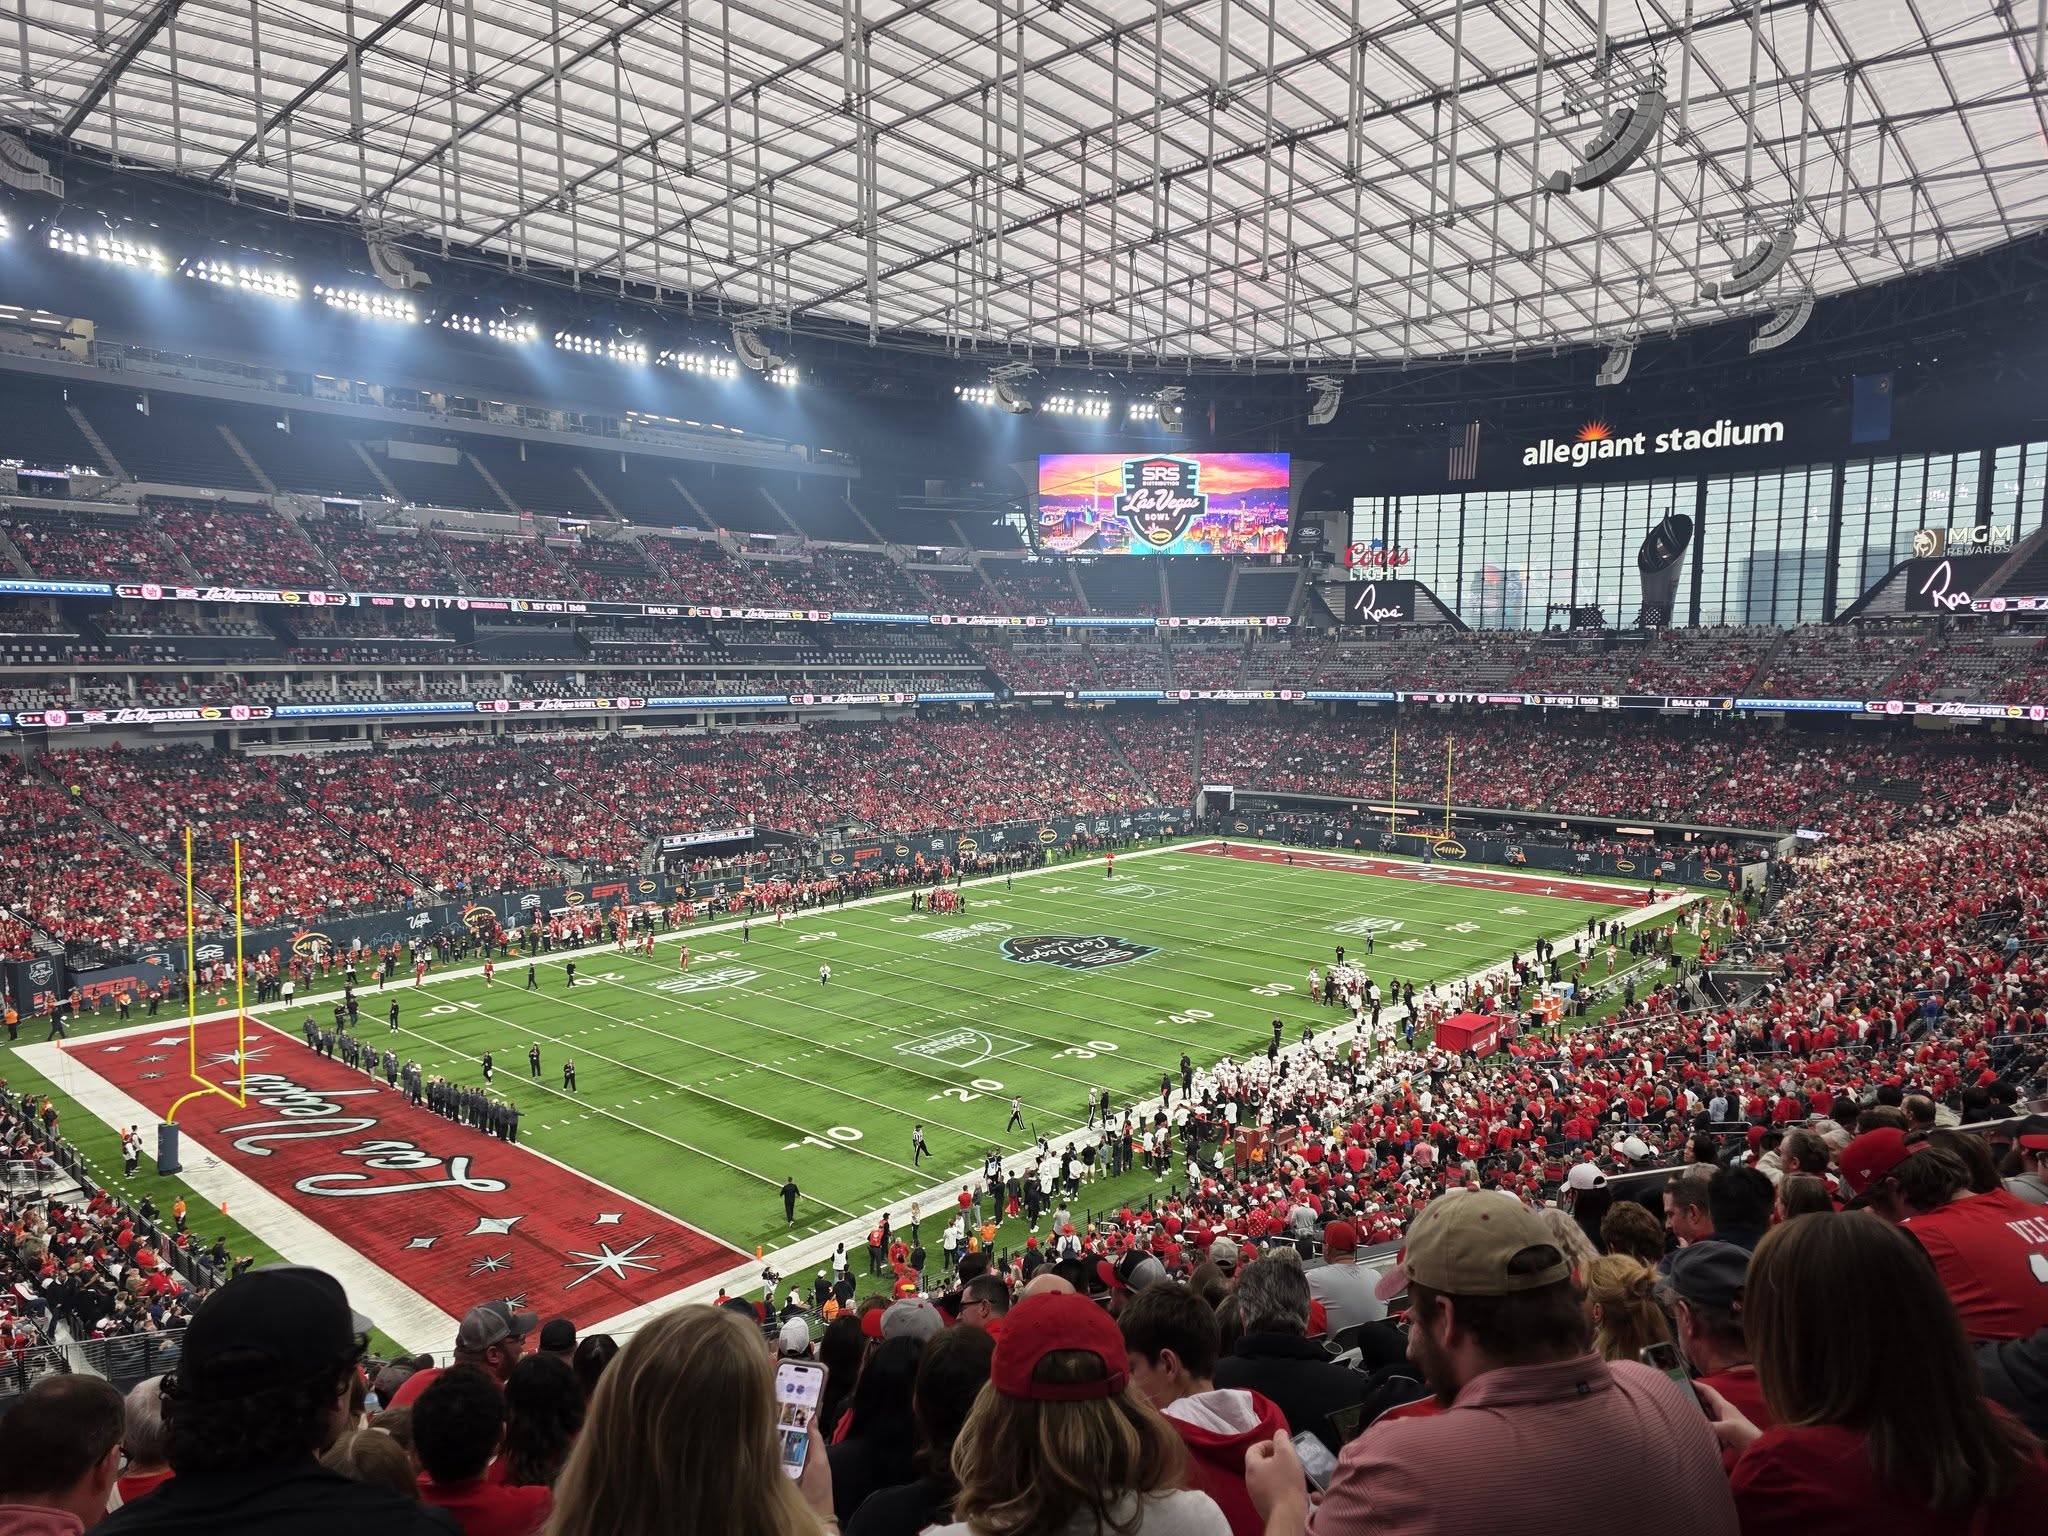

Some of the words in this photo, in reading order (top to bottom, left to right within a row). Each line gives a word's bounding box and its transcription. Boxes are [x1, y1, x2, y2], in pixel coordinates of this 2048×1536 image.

[1522, 432, 1646, 467] allegiant
[1654, 419, 1784, 454] stadium
[1142, 466, 1180, 480] SRS
[1122, 488, 1156, 513] Las
[1154, 488, 1200, 517] Vegas
[1145, 513, 1170, 521] BOWL
[1947, 524, 2012, 545] MGM
[1344, 542, 1411, 567] Coors
[1947, 545, 2011, 556] REWARDS
[1350, 567, 1402, 581] LIGHT
[176, 589, 198, 599] SRS
[202, 587, 225, 600] Las
[222, 588, 253, 602] Vegas
[253, 593, 281, 601] BOWL
[421, 599, 430, 608] 0
[443, 600, 451, 608] 7
[546, 603, 562, 611] QTR
[1449, 694, 1456, 703] 0
[1466, 695, 1473, 703] 7
[1603, 697, 1617, 707] 25
[83, 712, 107, 723] SRS
[112, 708, 138, 722] Las
[133, 708, 168, 724] Vegas
[168, 710, 200, 721] BOWL
[1915, 703, 1933, 713] SRS
[1936, 702, 1955, 715] Las
[1954, 703, 1979, 716] Vegas
[1979, 706, 2006, 715] BOWL
[855, 847, 882, 860] ESPN
[592, 882, 629, 898] ESPN
[520, 897, 541, 908] SRS
[889, 914, 929, 922] 50
[799, 931, 837, 941] 40
[1073, 937, 1109, 949] Las
[196, 948, 225, 960] SRS
[694, 950, 741, 961] 30
[1019, 945, 1083, 962] Vegas
[1081, 949, 1134, 963] SRS
[573, 972, 625, 986] 20
[656, 968, 757, 992] SRS
[82, 975, 137, 998] ESPN
[1249, 983, 1296, 996] 50
[431, 1001, 483, 1014] 10
[1167, 1009, 1215, 1024] 40
[910, 1032, 976, 1051] CORNING
[922, 1037, 977, 1055] OWENS
[1490, 1031, 1497, 1047] N
[1064, 1040, 1119, 1058] 30
[943, 1079, 1004, 1102] 20
[219, 1073, 382, 1157] Vegas
[801, 1126, 864, 1149] 10
[294, 1140, 507, 1196] Las
